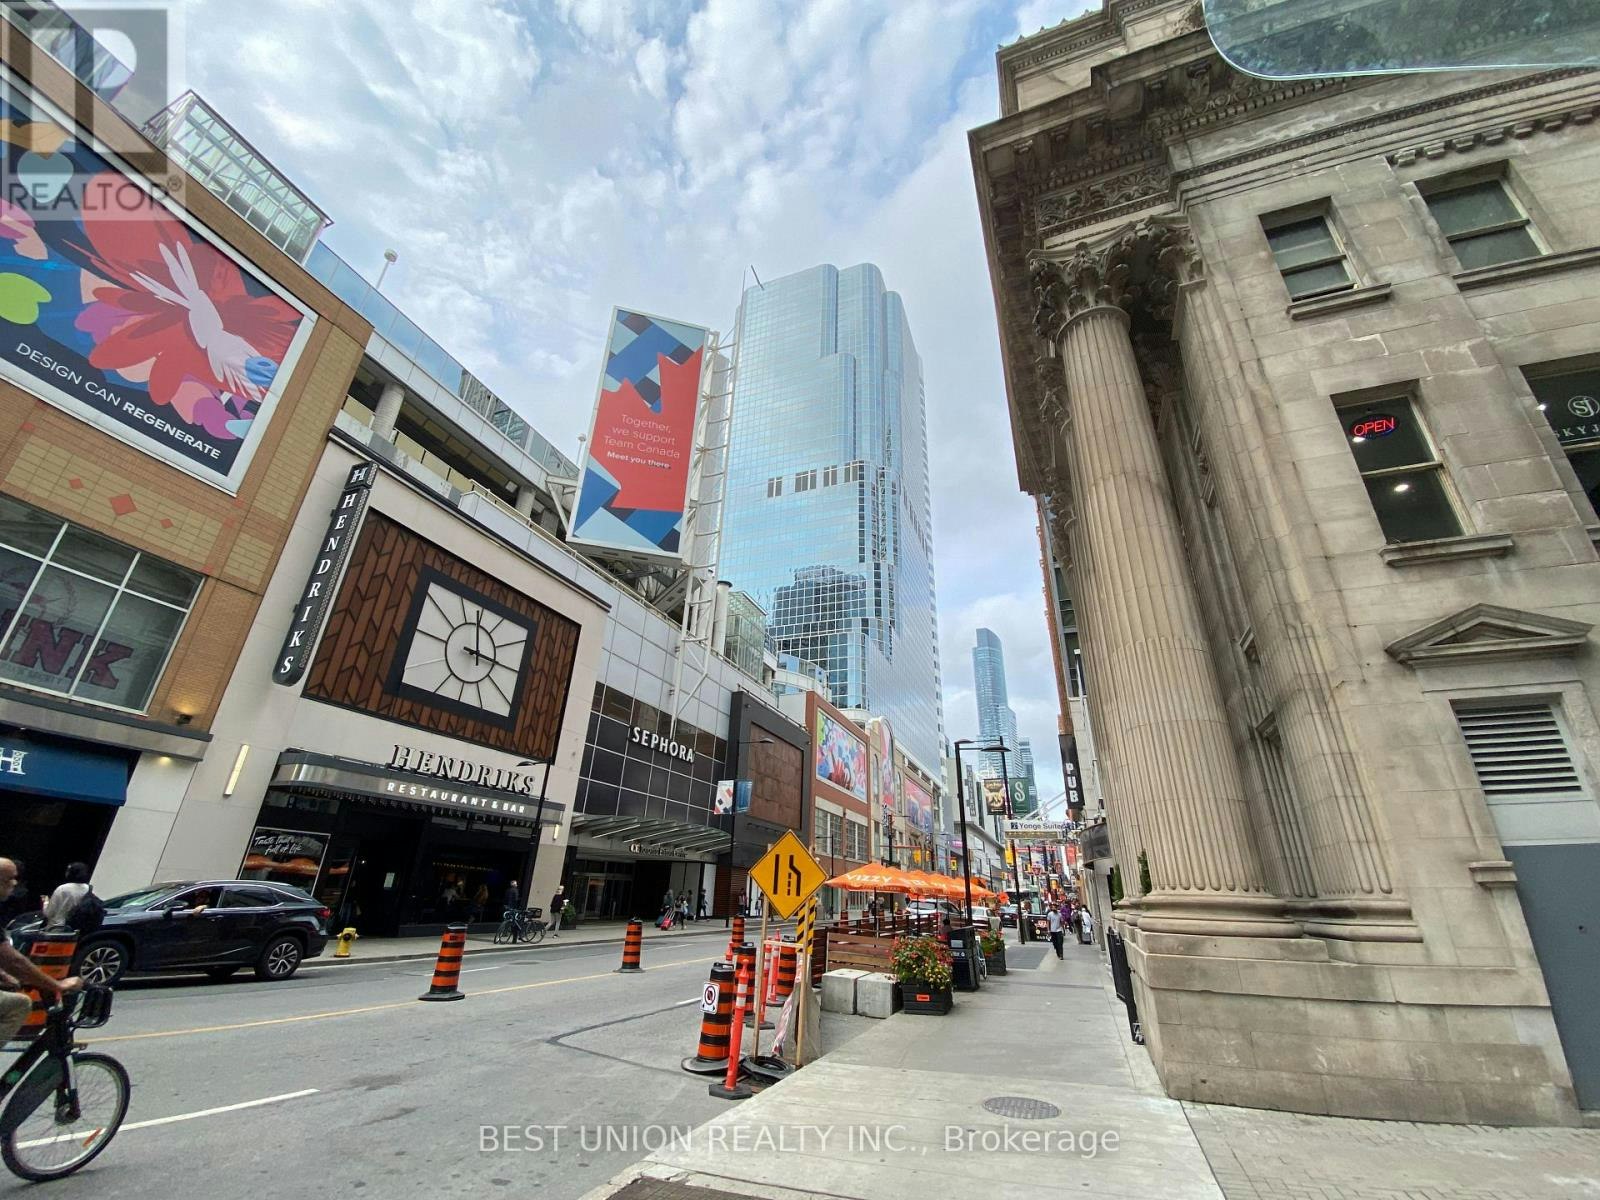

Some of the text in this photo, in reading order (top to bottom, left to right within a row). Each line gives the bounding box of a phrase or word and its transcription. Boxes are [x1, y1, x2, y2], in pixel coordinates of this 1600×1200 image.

[16, 342, 221, 460] DESIGN CAN REGENERATE
[612, 426, 676, 446] we support
[621, 414, 671, 434] Together,
[1354, 416, 1395, 437] OPEN
[604, 435, 680, 459] Team Canada
[607, 450, 672, 470] Meet you there.
[280, 493, 357, 673] HENDRIKS
[632, 726, 694, 764] SEPHORA
[390, 744, 535, 795] HENDRIKS
[1065, 762, 1079, 803] PUB
[386, 782, 525, 814] RESTAURANT & BAR
[1019, 822, 1042, 831] Yonge
[846, 873, 892, 883] VIZZY
